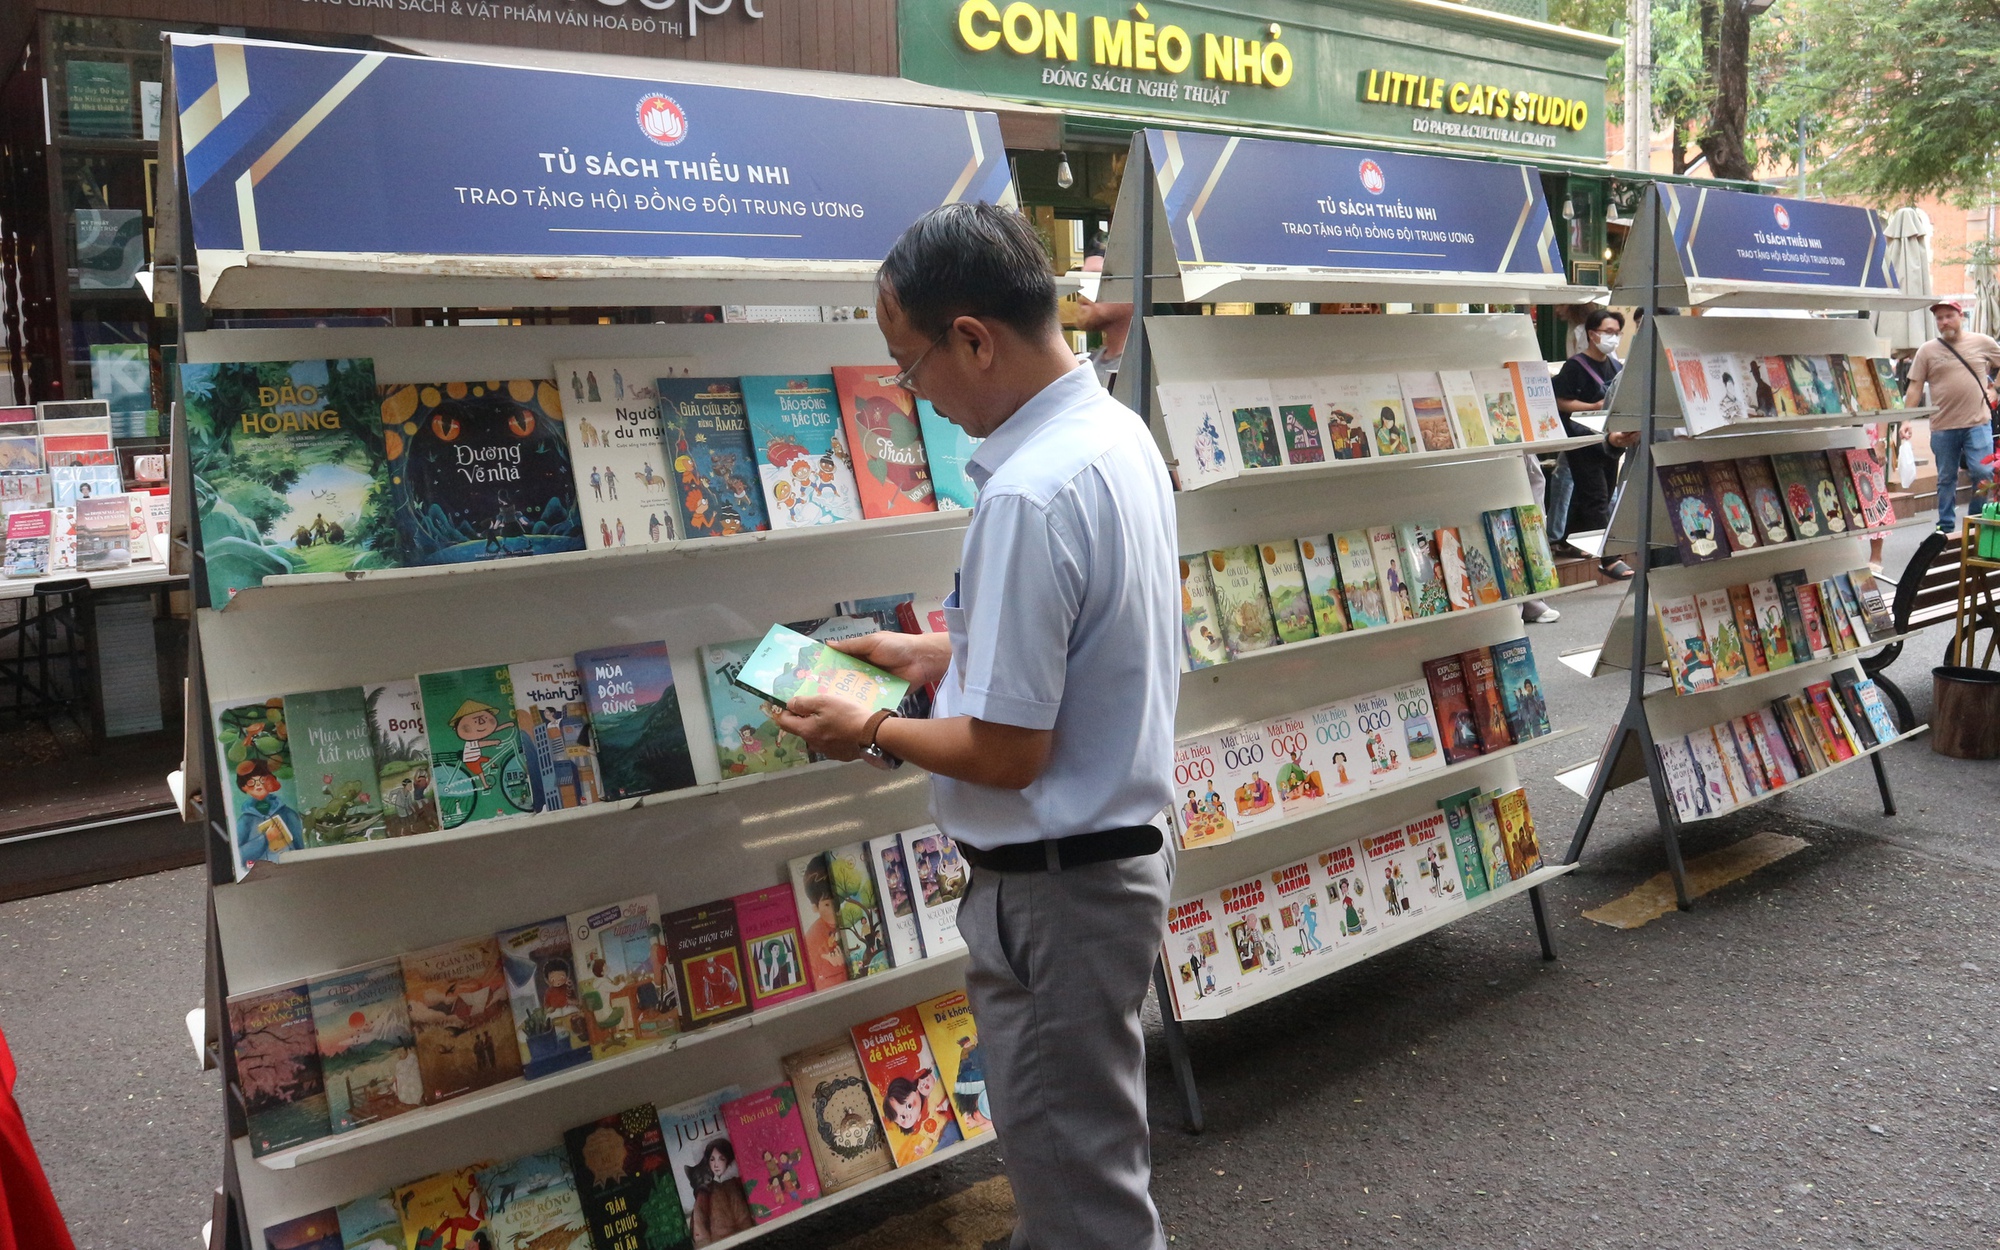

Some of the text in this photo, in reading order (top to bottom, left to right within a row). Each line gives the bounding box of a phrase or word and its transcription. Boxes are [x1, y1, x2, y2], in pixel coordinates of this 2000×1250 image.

[450, 4, 463, 15] &
[467, 2, 500, 20] VẬT
[503, 3, 551, 23] PHẨM
[555, 10, 588, 27] VĂN
[593, 14, 628, 30] HOÁ
[631, 16, 655, 33] ĐÔ
[659, 21, 683, 38] THỊ
[958, 0, 1294, 89] CON MÈO NHỎ
[1042, 67, 1230, 107] ĐÓNG SÁCH NGHỆ THUẬT
[1366, 68, 1588, 131] LITTLE CATS STUDIO
[1520, 132, 1557, 148] CRAFTS
[539, 147, 790, 185] TỦ SÁCH THIẾU NHI
[454, 186, 865, 219] TRAO TẶNG HỘI ĐỒNG ĐỘI TRUNG ƯƠNG
[1317, 196, 1438, 221] TỦ SÁCH THIẾU NHI
[1282, 222, 1475, 244] TRAO TẶNG HỘI ĐỒNG ĐỘI TRUNG ƯƠNG
[1754, 230, 1822, 249] TỦ SÁCH THIẾU NHI
[259, 377, 318, 407] ĐẢO
[702, 402, 721, 415] CỨU
[780, 395, 827, 413] BÁO ĐỘNG
[241, 409, 342, 434] HOANG
[615, 405, 662, 426] Người
[791, 410, 811, 428] BẮC
[811, 412, 831, 426] CỰC
[615, 425, 635, 439] du
[454, 443, 521, 465] Đường
[876, 437, 915, 464] Trái
[457, 464, 520, 484] Về nhà
[916, 468, 928, 480] VÀ
[531, 672, 557, 684] Tìm
[595, 663, 623, 681] MÙA
[598, 680, 634, 700] ĐỘNG
[1393, 686, 1426, 703] Mật hiệu
[602, 699, 638, 716] RỪNG
[1354, 697, 1388, 715] Mật hiệu
[1312, 707, 1348, 727] Mật hiệu
[308, 727, 342, 746] Mưa
[1267, 719, 1305, 738] Mật hiệu
[1220, 730, 1260, 751] Mật hiệu
[317, 742, 342, 765] đất
[1190, 744, 1212, 760] hiệu
[1406, 814, 1444, 836] SALVADOR
[1372, 829, 1402, 847] VINCENT
[1328, 847, 1353, 864] FRIDA
[1367, 839, 1405, 859] VAN GOGH
[1282, 863, 1309, 881] KEITH
[1327, 857, 1355, 877] KAHLO
[1231, 879, 1262, 899] PABLO
[1276, 874, 1311, 895] HARING
[1177, 899, 1204, 918] ANDY
[1223, 891, 1265, 915] PICASSO
[1168, 910, 1213, 934] WARHOL
[895, 1024, 913, 1038] sức
[885, 1036, 918, 1057] kháng
[604, 1213, 638, 1239] DI CHÚC
